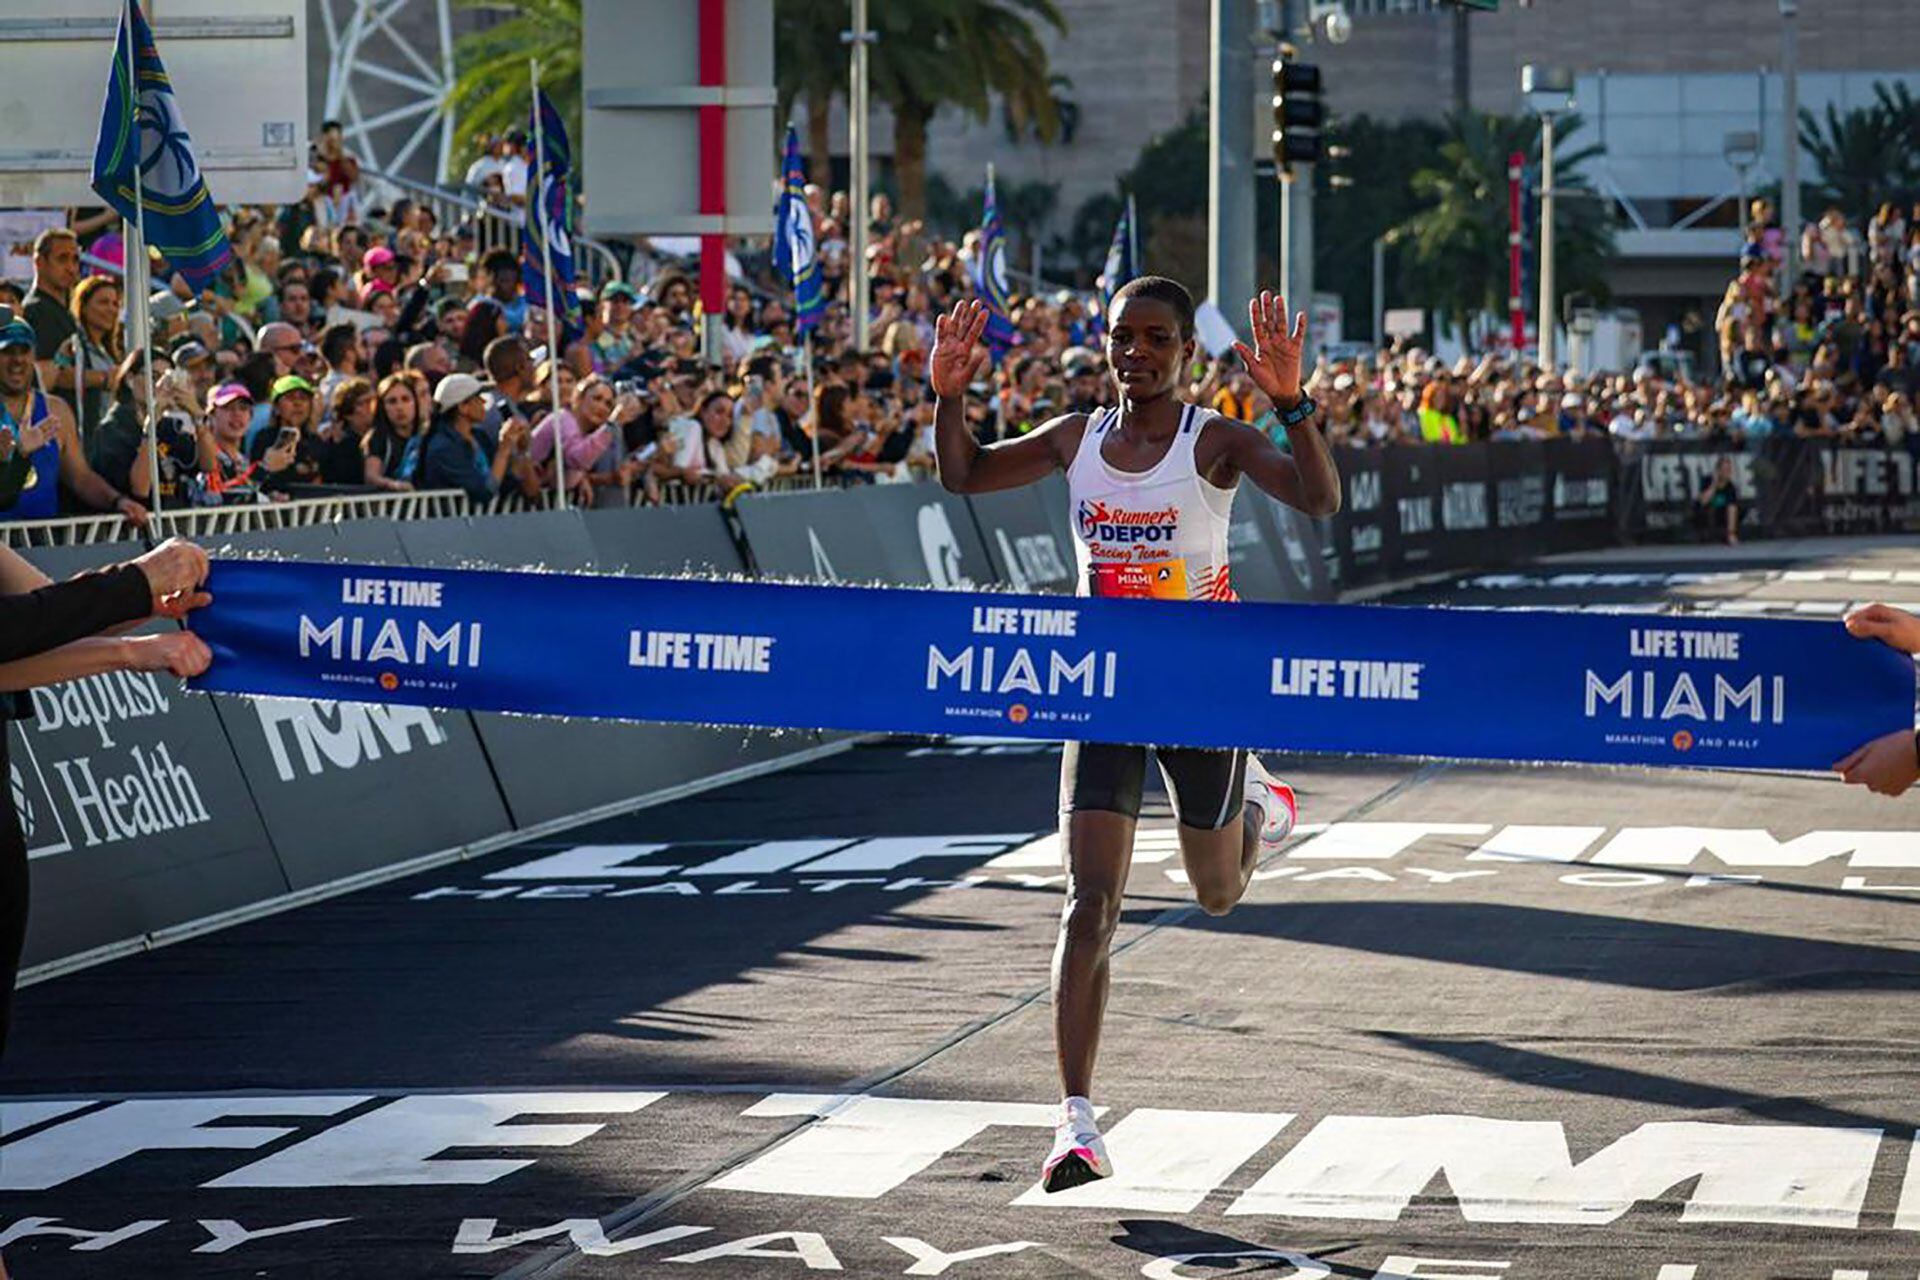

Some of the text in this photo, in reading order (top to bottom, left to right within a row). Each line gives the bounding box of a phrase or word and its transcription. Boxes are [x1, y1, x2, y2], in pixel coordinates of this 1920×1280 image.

[1110, 507, 1179, 524] Runner's
[1100, 525, 1177, 542] DEPOT
[1088, 541, 1171, 562] Racing Team
[342, 578, 442, 607] LIFE TIME
[1117, 574, 1153, 585] MIAMI
[973, 606, 1076, 637] LIFE TIME
[299, 614, 481, 667] MIAMI
[629, 630, 771, 673] LIFE TIME
[1630, 628, 1739, 660] LIFE TIME
[321, 673, 458, 690] MARATHON AND HALF
[926, 644, 1117, 698] MIAMI
[1271, 657, 1420, 700] LIFE TIME
[1585, 668, 1784, 724] MIAMI
[944, 706, 1092, 721] MARATHON AND HALF
[1605, 734, 1759, 749] MARATHON AND HALF
[53, 741, 211, 847] Health
[451, 1217, 1048, 1277] WAY
